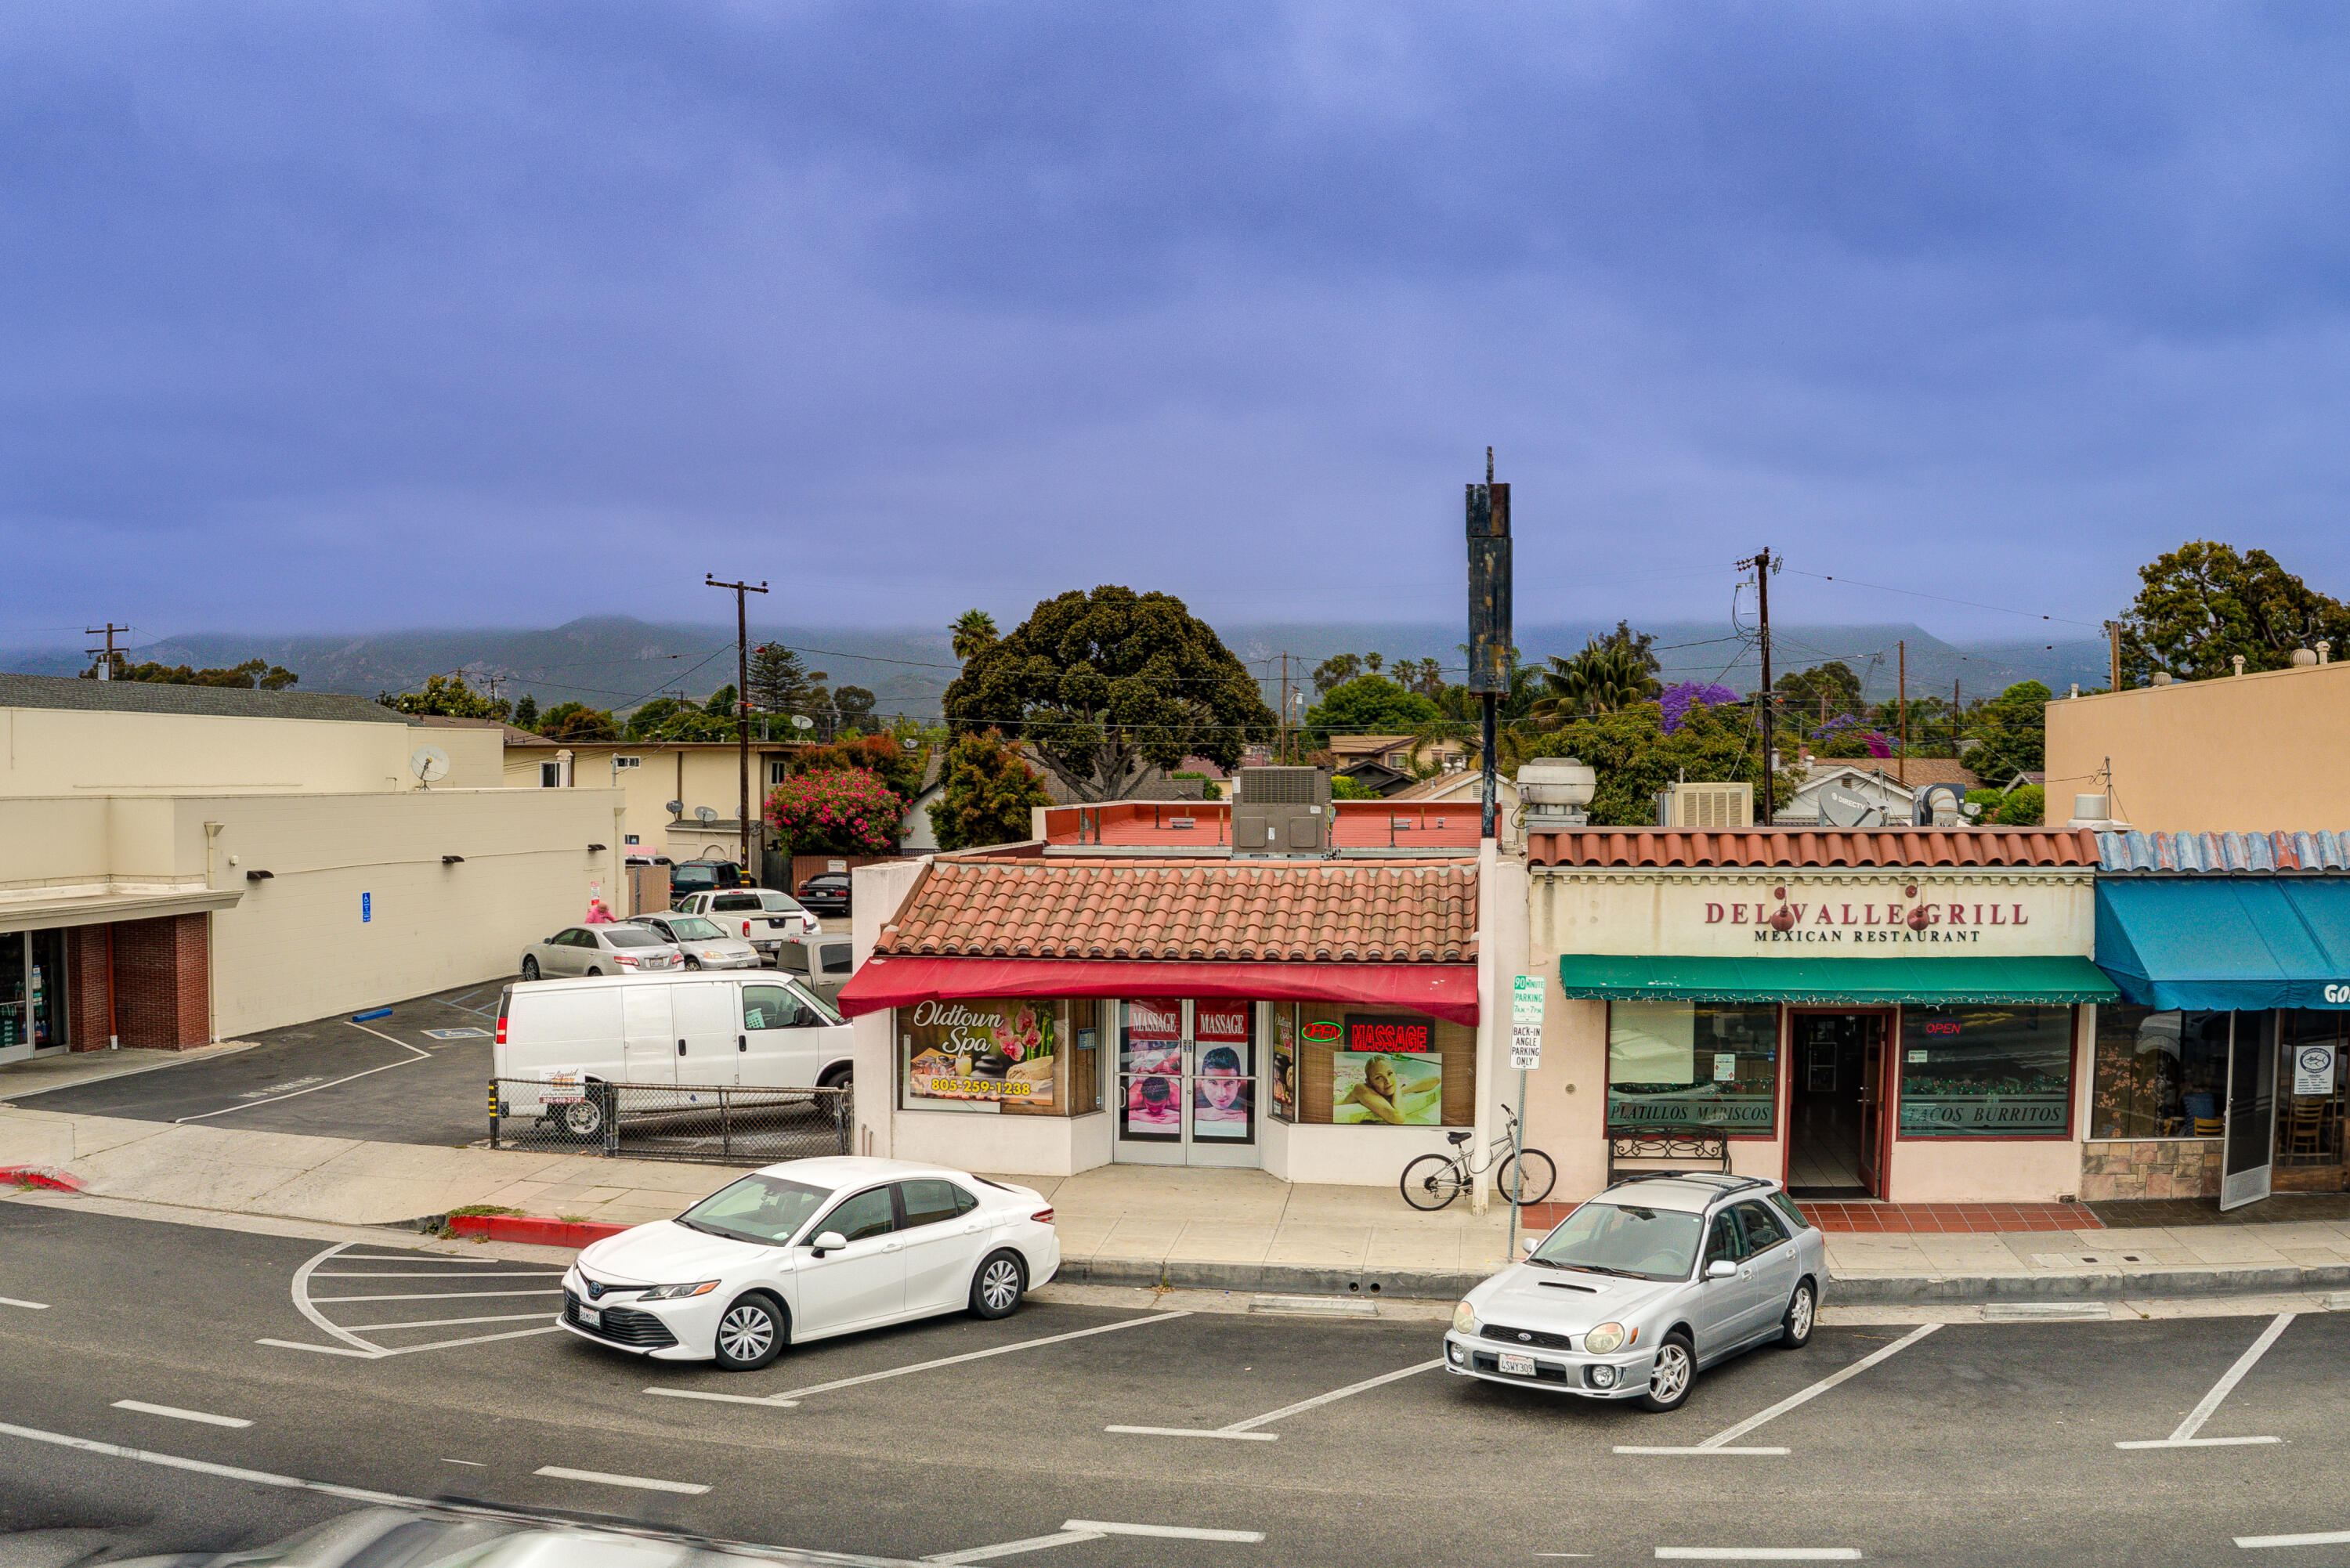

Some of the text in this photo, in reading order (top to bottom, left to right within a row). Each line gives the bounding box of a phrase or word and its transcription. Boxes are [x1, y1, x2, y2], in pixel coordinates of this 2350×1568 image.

[1838, 796, 1866, 810] DIRECTV
[1705, 903, 2029, 926] DEL VALLE GRILL
[1754, 930, 1980, 943] MEXICAN RESTAURANT
[1515, 977, 1544, 989] 90 MINUTE
[1515, 993, 1542, 1003] PARKING
[2323, 984, 2350, 1003] GO
[914, 999, 1005, 1028] Oldtown
[1133, 1012, 1177, 1032] MASSAGE
[1199, 1013, 1244, 1035] MASSAGE
[1925, 1023, 1962, 1035] OPEN
[1303, 1023, 1342, 1040] OPEN
[1351, 1024, 1428, 1053] MASSAGE
[1513, 1027, 1541, 1037] BACK-IN
[942, 1026, 992, 1058] Spa
[1516, 1038, 1536, 1046] ANGLE
[1512, 1046, 1539, 1057] PARKING
[1517, 1057, 1533, 1066] ONLY
[931, 1078, 1032, 1095] 805-259-1238
[1611, 1104, 1688, 1120] PLATILLOS
[1973, 1106, 2061, 1122] BURRITOS
[1501, 1360, 1533, 1372] 4SWY309
